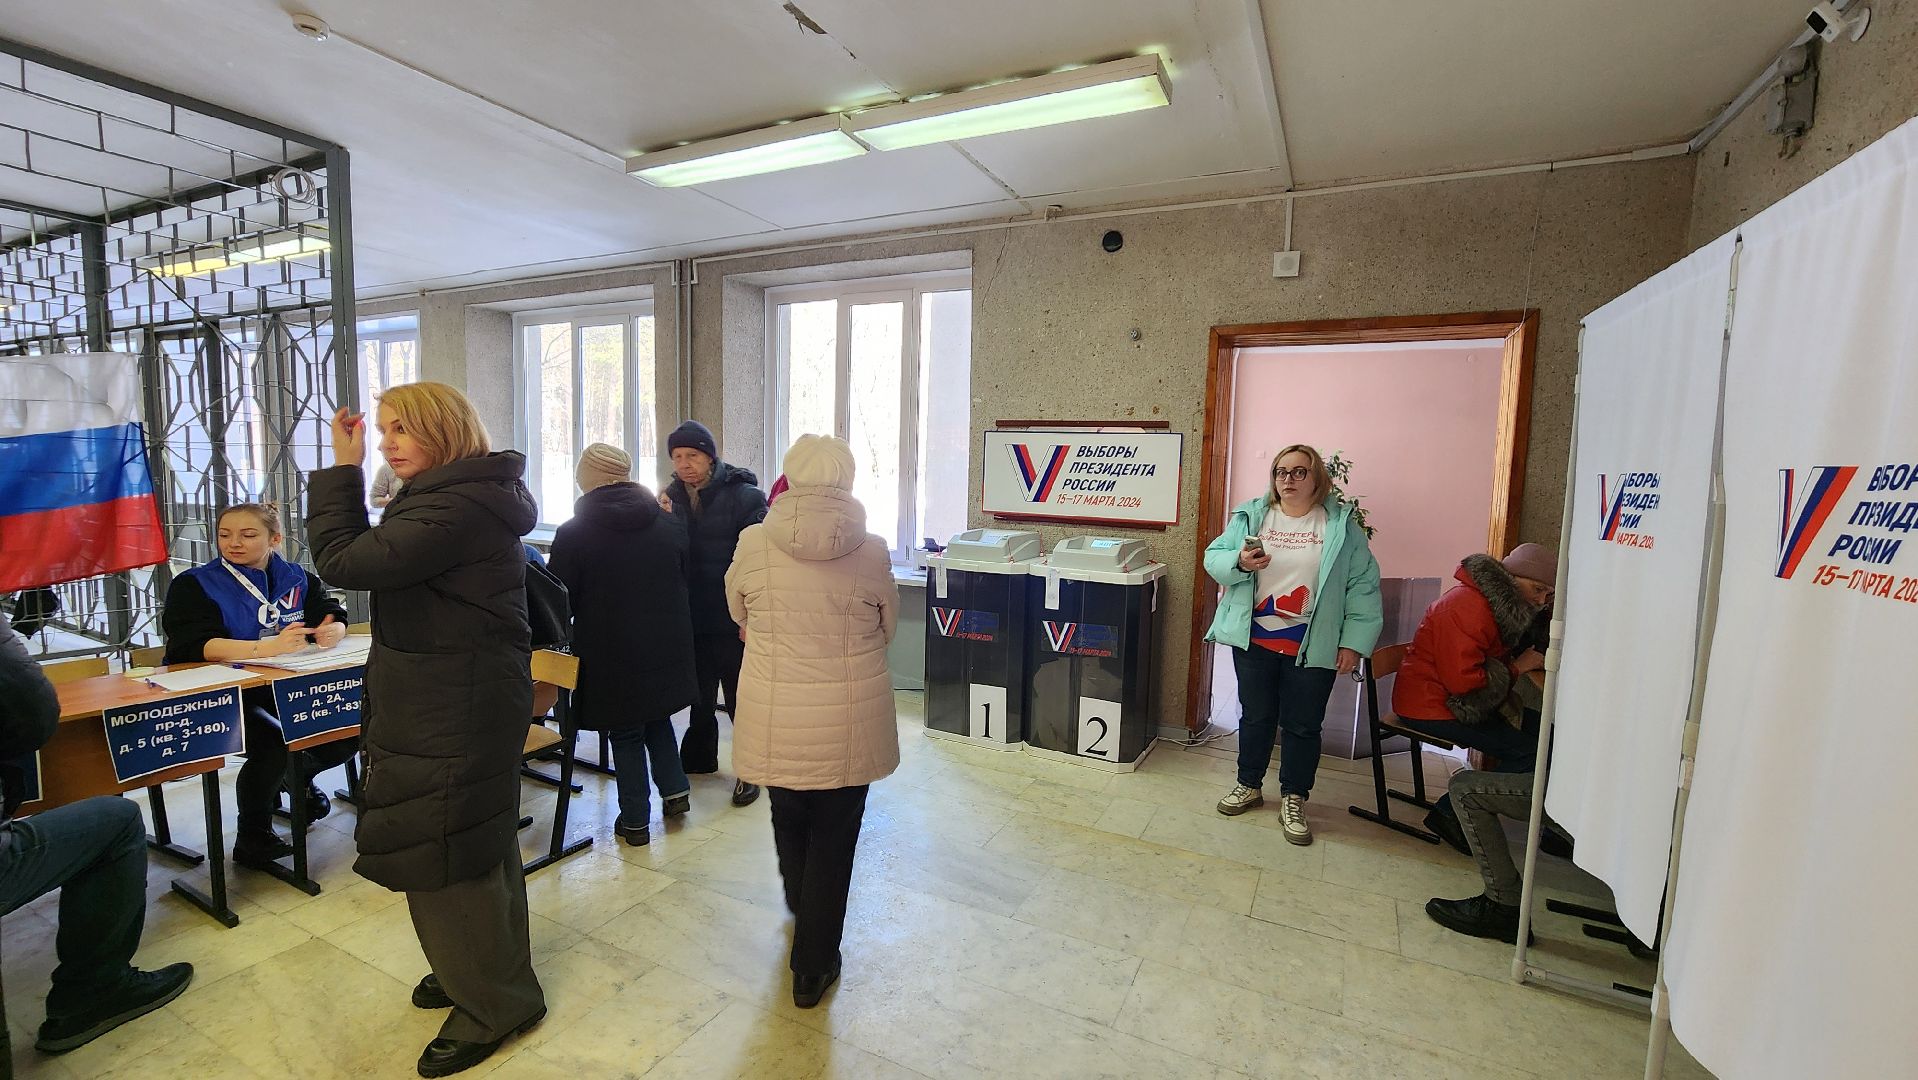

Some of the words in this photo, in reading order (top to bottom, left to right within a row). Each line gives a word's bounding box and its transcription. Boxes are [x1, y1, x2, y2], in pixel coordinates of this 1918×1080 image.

[1076, 445, 1139, 459] ВЫБОРЫ
[1069, 462, 1156, 477] ПРЕЗИДЕНТА
[1866, 463, 1918, 491] ВБОР
[1062, 478, 1117, 492] РОССИИ
[1083, 495, 1116, 507] МАРТА
[1117, 496, 1142, 508] 2024
[287, 690, 306, 702] ул.
[309, 677, 363, 696] ПОБЕДЫ
[312, 699, 323, 708] д.
[326, 693, 345, 704] 2А,
[110, 693, 233, 728] МОЛОДЕЖНЫЙ
[292, 711, 308, 723] 2Б
[311, 708, 332, 720] (кв.
[155, 717, 194, 732] пр-д.
[980, 702, 993, 739] 1
[119, 743, 133, 755] д.
[137, 738, 146, 749] 5
[151, 734, 178, 747] (кв.
[182, 721, 230, 739] 3-180),
[1084, 716, 1109, 757] 2
[162, 746, 176, 757] д.
[181, 741, 189, 752] 7
